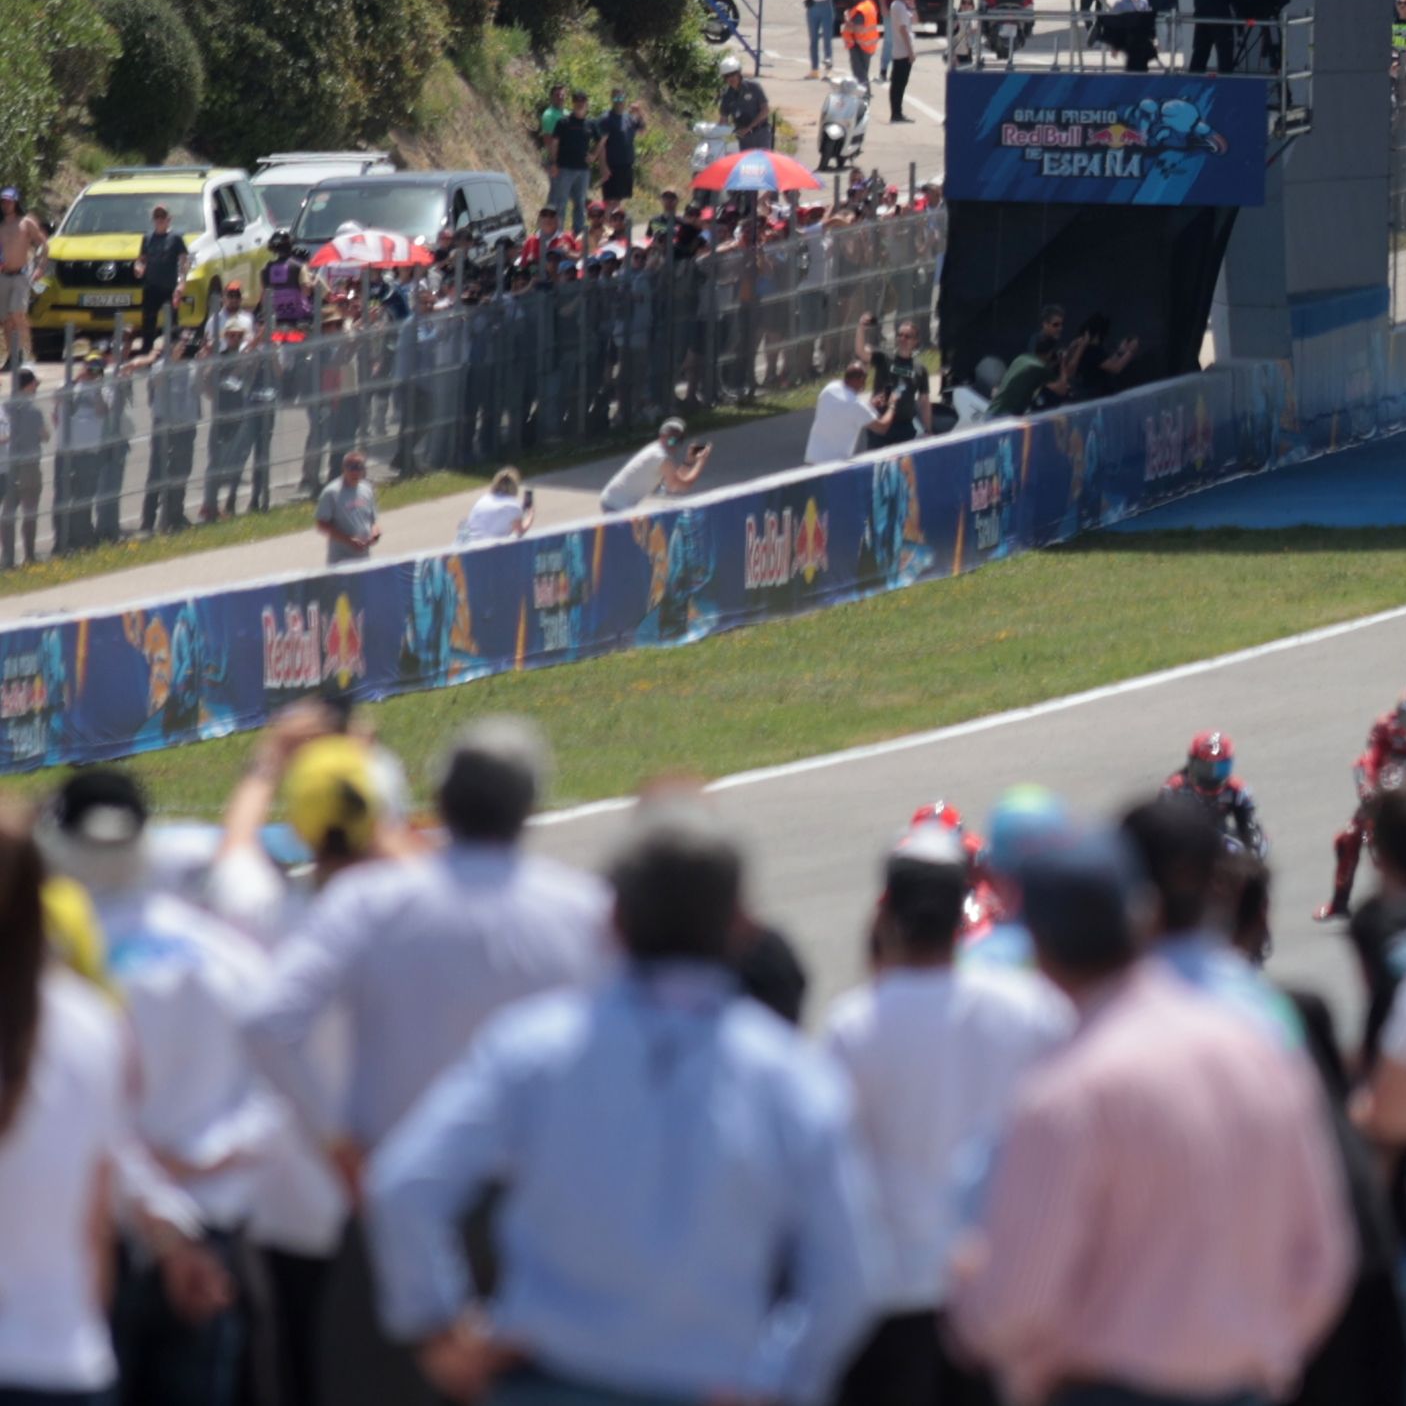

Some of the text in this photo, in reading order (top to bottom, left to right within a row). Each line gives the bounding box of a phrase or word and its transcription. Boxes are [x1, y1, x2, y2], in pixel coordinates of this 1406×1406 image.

[1013, 109, 1118, 124] GRAN PREMIO
[1042, 149, 1142, 178] ESPAÑA
